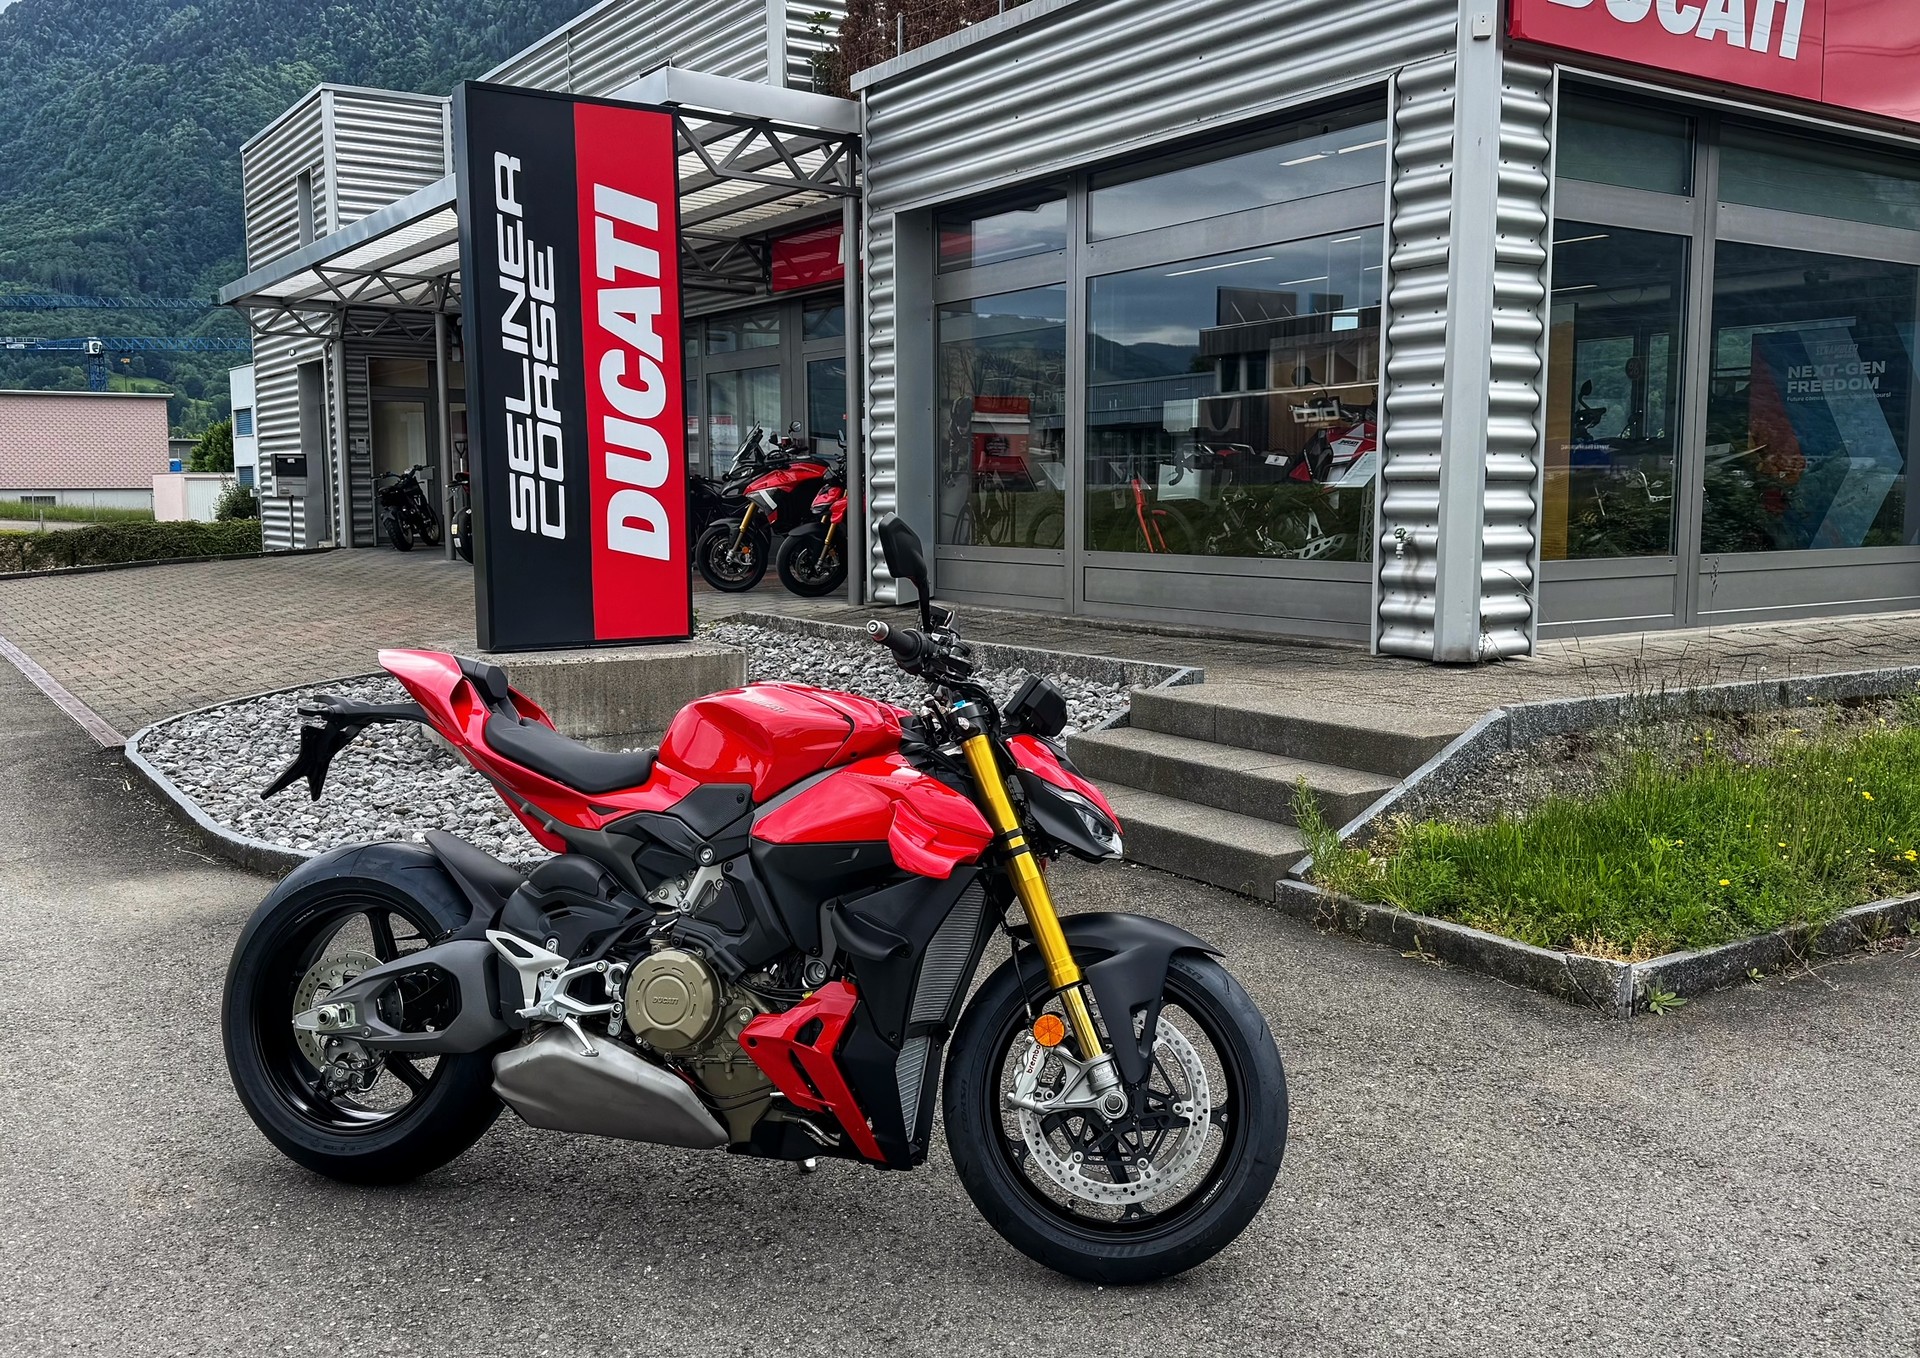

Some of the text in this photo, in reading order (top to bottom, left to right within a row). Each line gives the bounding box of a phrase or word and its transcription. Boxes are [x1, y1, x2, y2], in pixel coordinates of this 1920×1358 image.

[1548, 0, 1806, 60] CATI
[493, 151, 537, 534] SELINER
[593, 182, 671, 561] DUCATI
[1787, 361, 1886, 379] NEXT-GEN
[1787, 376, 1880, 393] FREEDOM
[527, 239, 566, 540] CORSE
[1028, 389, 1066, 402] e-Roa
[652, 996, 679, 1005] DUCATI
[1026, 1044, 1041, 1074] brembo
